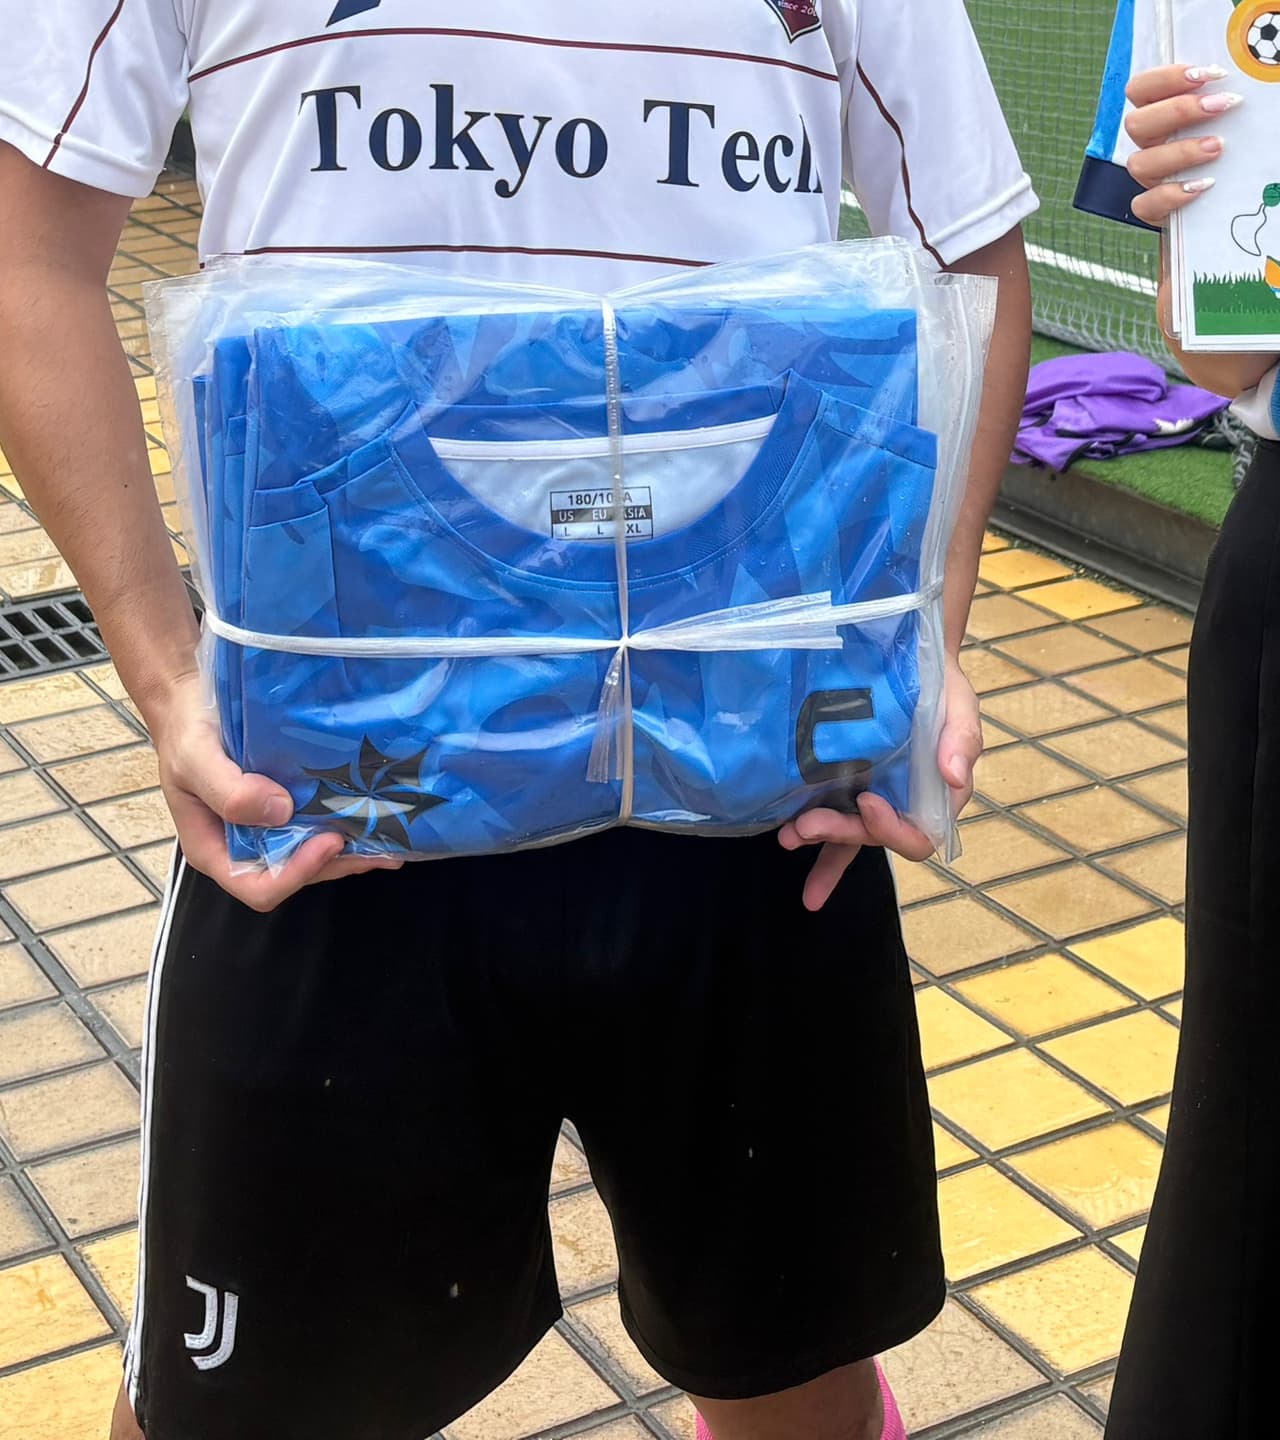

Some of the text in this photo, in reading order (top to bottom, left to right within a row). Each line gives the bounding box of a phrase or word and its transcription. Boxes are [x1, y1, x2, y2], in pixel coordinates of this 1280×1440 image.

[299, 83, 609, 199] Tokyo
[559, 510, 574, 522] US
[592, 508, 608, 521] EU
[626, 522, 642, 534] XL
